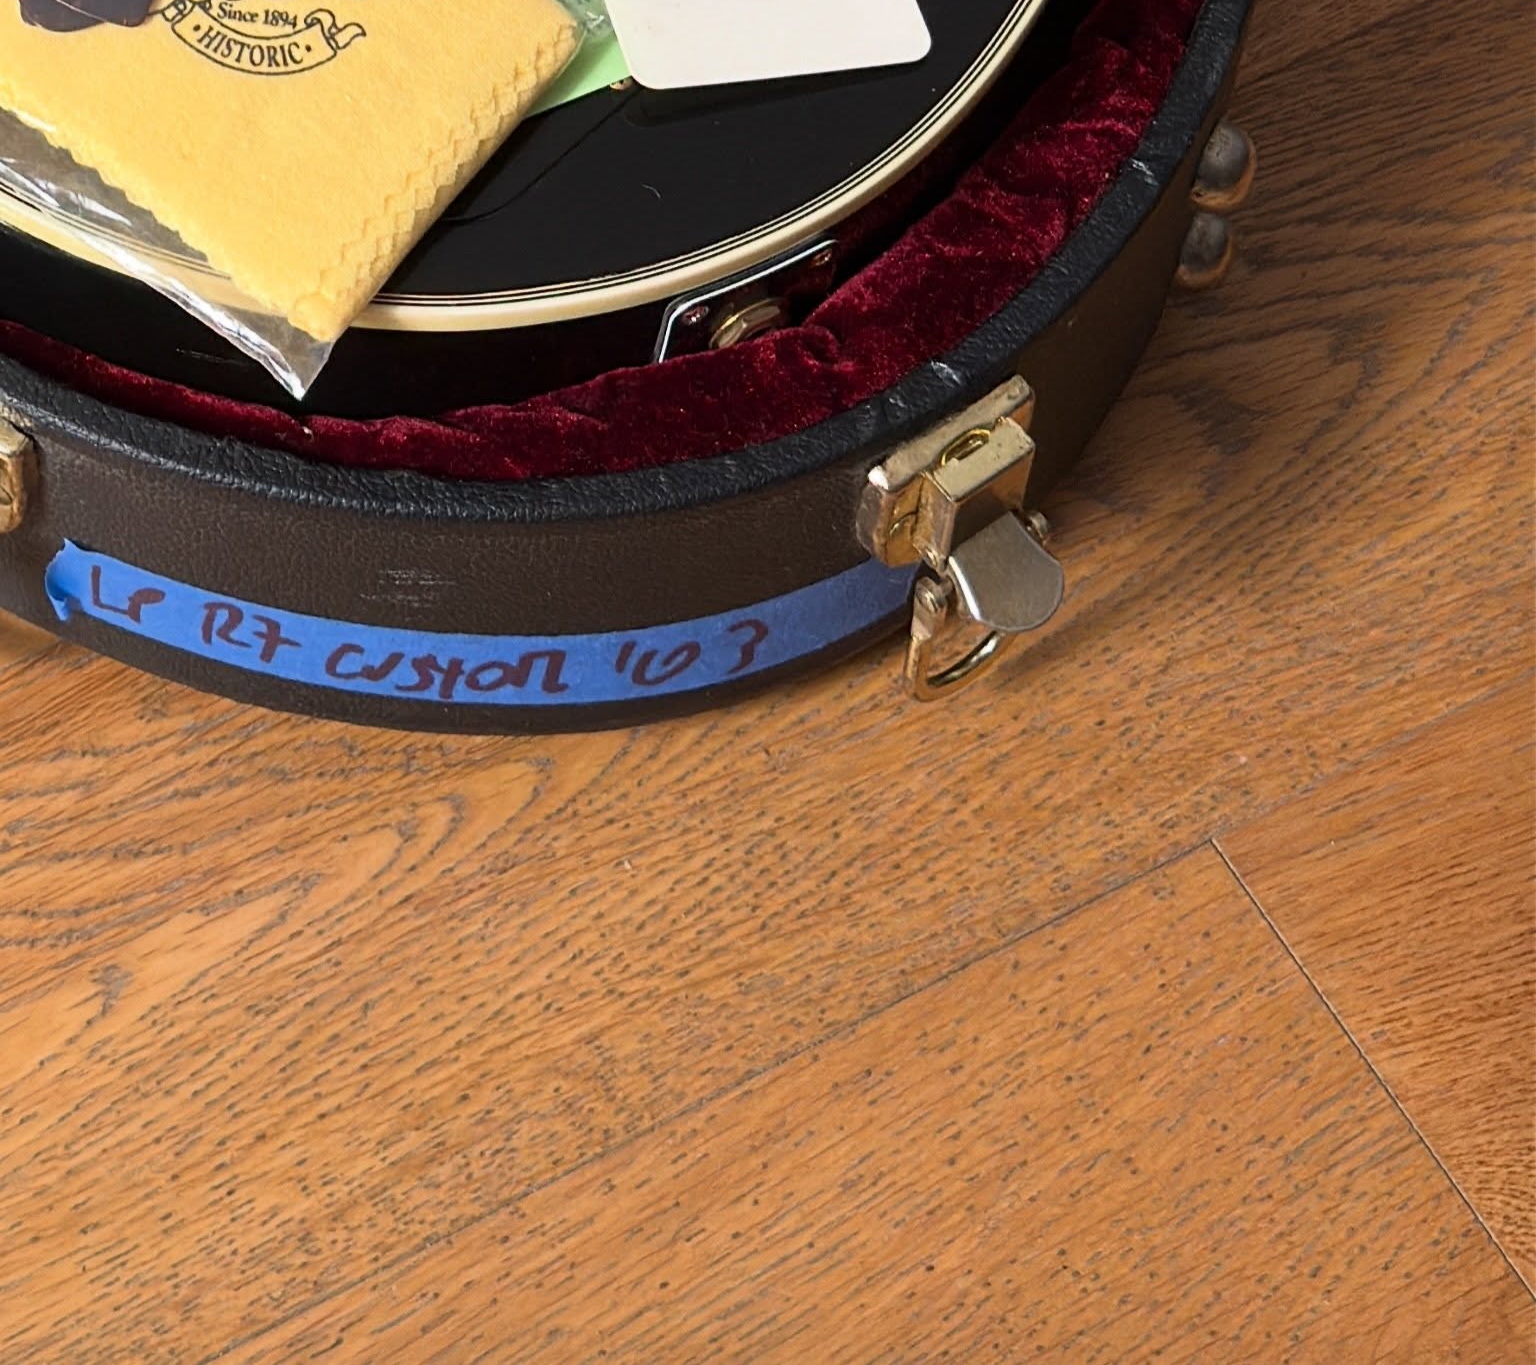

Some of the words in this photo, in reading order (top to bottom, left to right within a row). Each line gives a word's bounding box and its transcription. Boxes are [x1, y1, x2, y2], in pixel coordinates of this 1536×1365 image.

[217, 2, 259, 23] Since
[263, 8, 298, 28] 1894
[197, 25, 304, 68] HISTORIC
